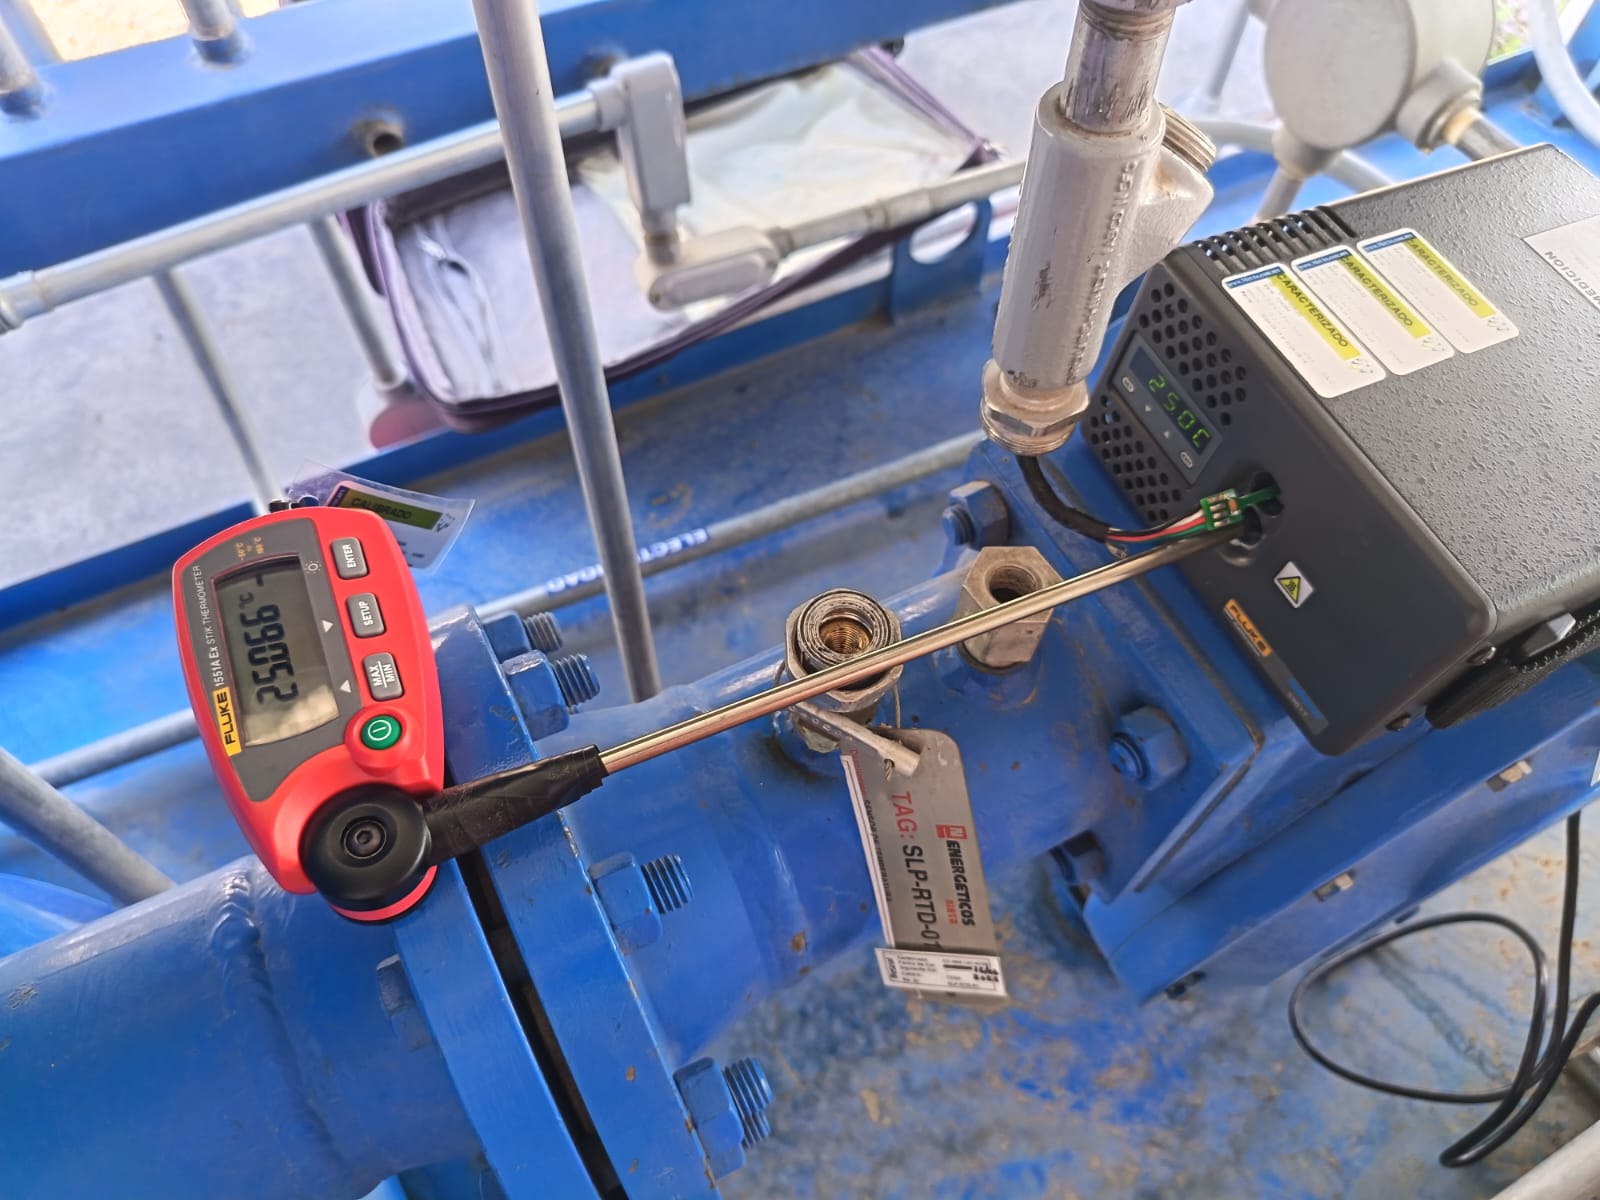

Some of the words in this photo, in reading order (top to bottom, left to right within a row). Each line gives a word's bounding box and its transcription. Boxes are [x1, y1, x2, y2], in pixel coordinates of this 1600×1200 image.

[1405, 239, 1480, 307] CARACTERIZADO
[1339, 256, 1414, 327] CARACTERIZADO
[1276, 273, 1350, 348] CARACTERIZADO
[351, 497, 412, 520] CALIBRADO
[342, 544, 357, 569] ENTER
[192, 565, 212, 626] THERMOMETER
[358, 600, 374, 626] SETUP
[206, 626, 217, 645] STIK
[208, 646, 221, 659] Ex
[213, 659, 229, 688] 1551A
[368, 666, 384, 687] MAX
[382, 662, 395, 683] MIN
[214, 689, 235, 745] FLUKE
[891, 791, 918, 840] TAG:
[946, 839, 976, 927] ENERGETICOS
